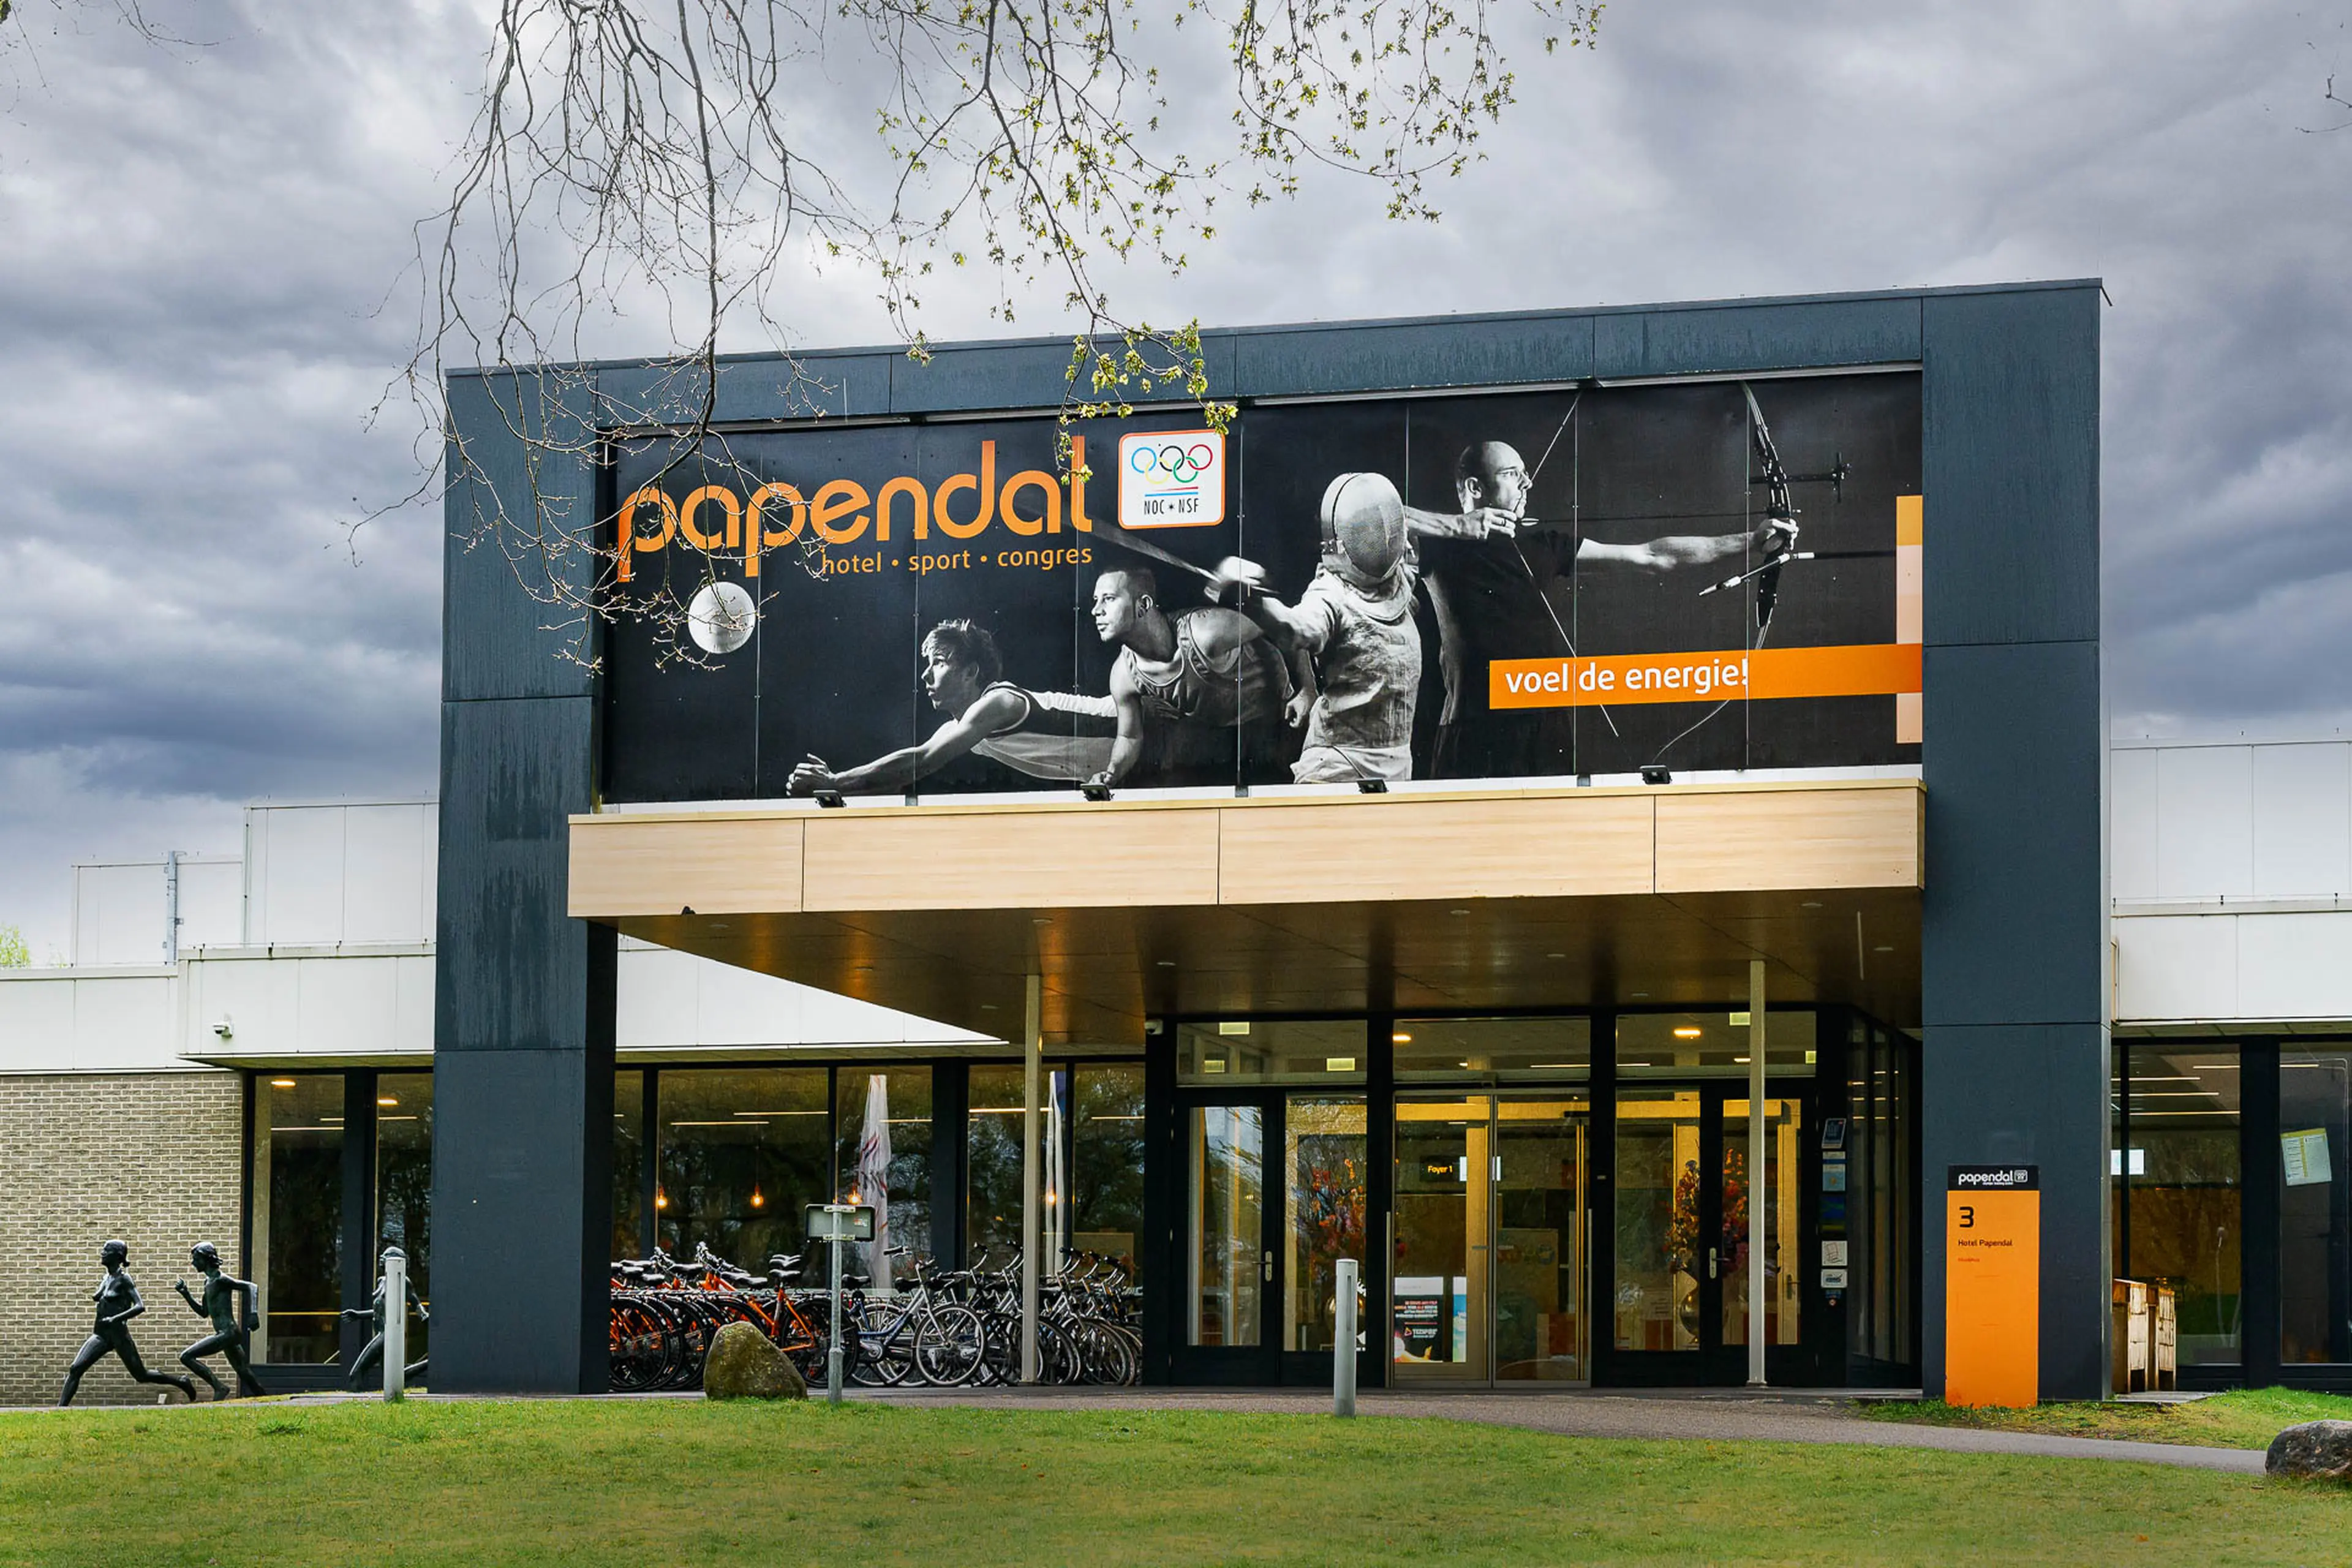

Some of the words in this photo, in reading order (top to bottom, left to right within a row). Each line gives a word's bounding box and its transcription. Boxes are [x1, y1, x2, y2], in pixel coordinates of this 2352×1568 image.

[617, 435, 1093, 582] papendal
[1144, 499, 1164, 514] NOC
[1178, 498, 1199, 513] NSF
[822, 551, 881, 574] hotel
[909, 550, 971, 576] sport
[998, 547, 1092, 570] congres
[1505, 663, 1568, 693] voel
[1578, 662, 1615, 691] de
[1625, 658, 1747, 695] energie!
[1428, 1166, 1448, 1174] Foyer
[1958, 1170, 2013, 1185] papendal
[1959, 1207, 1974, 1227] 3
[1979, 1239, 2012, 1248] Papendal
